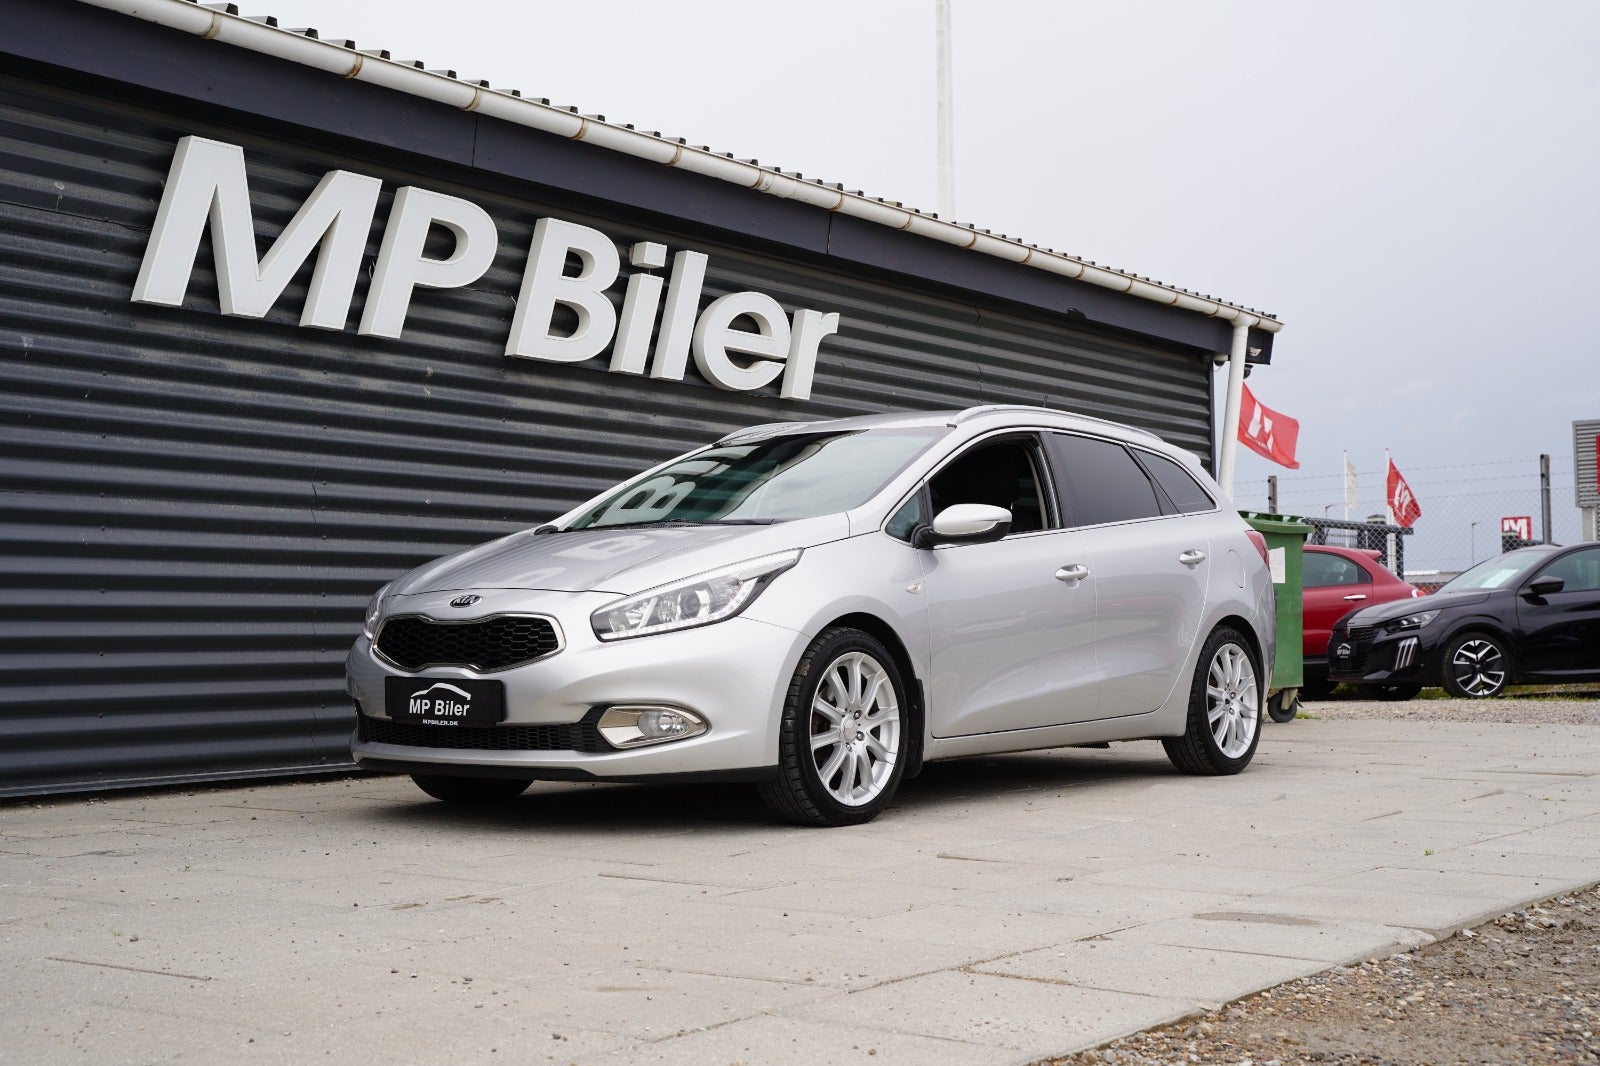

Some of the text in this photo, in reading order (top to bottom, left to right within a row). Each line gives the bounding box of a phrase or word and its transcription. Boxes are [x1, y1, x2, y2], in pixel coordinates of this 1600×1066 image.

[131, 134, 841, 400] MP Biler
[451, 594, 481, 606] KIA
[409, 699, 470, 716] MP Biler
